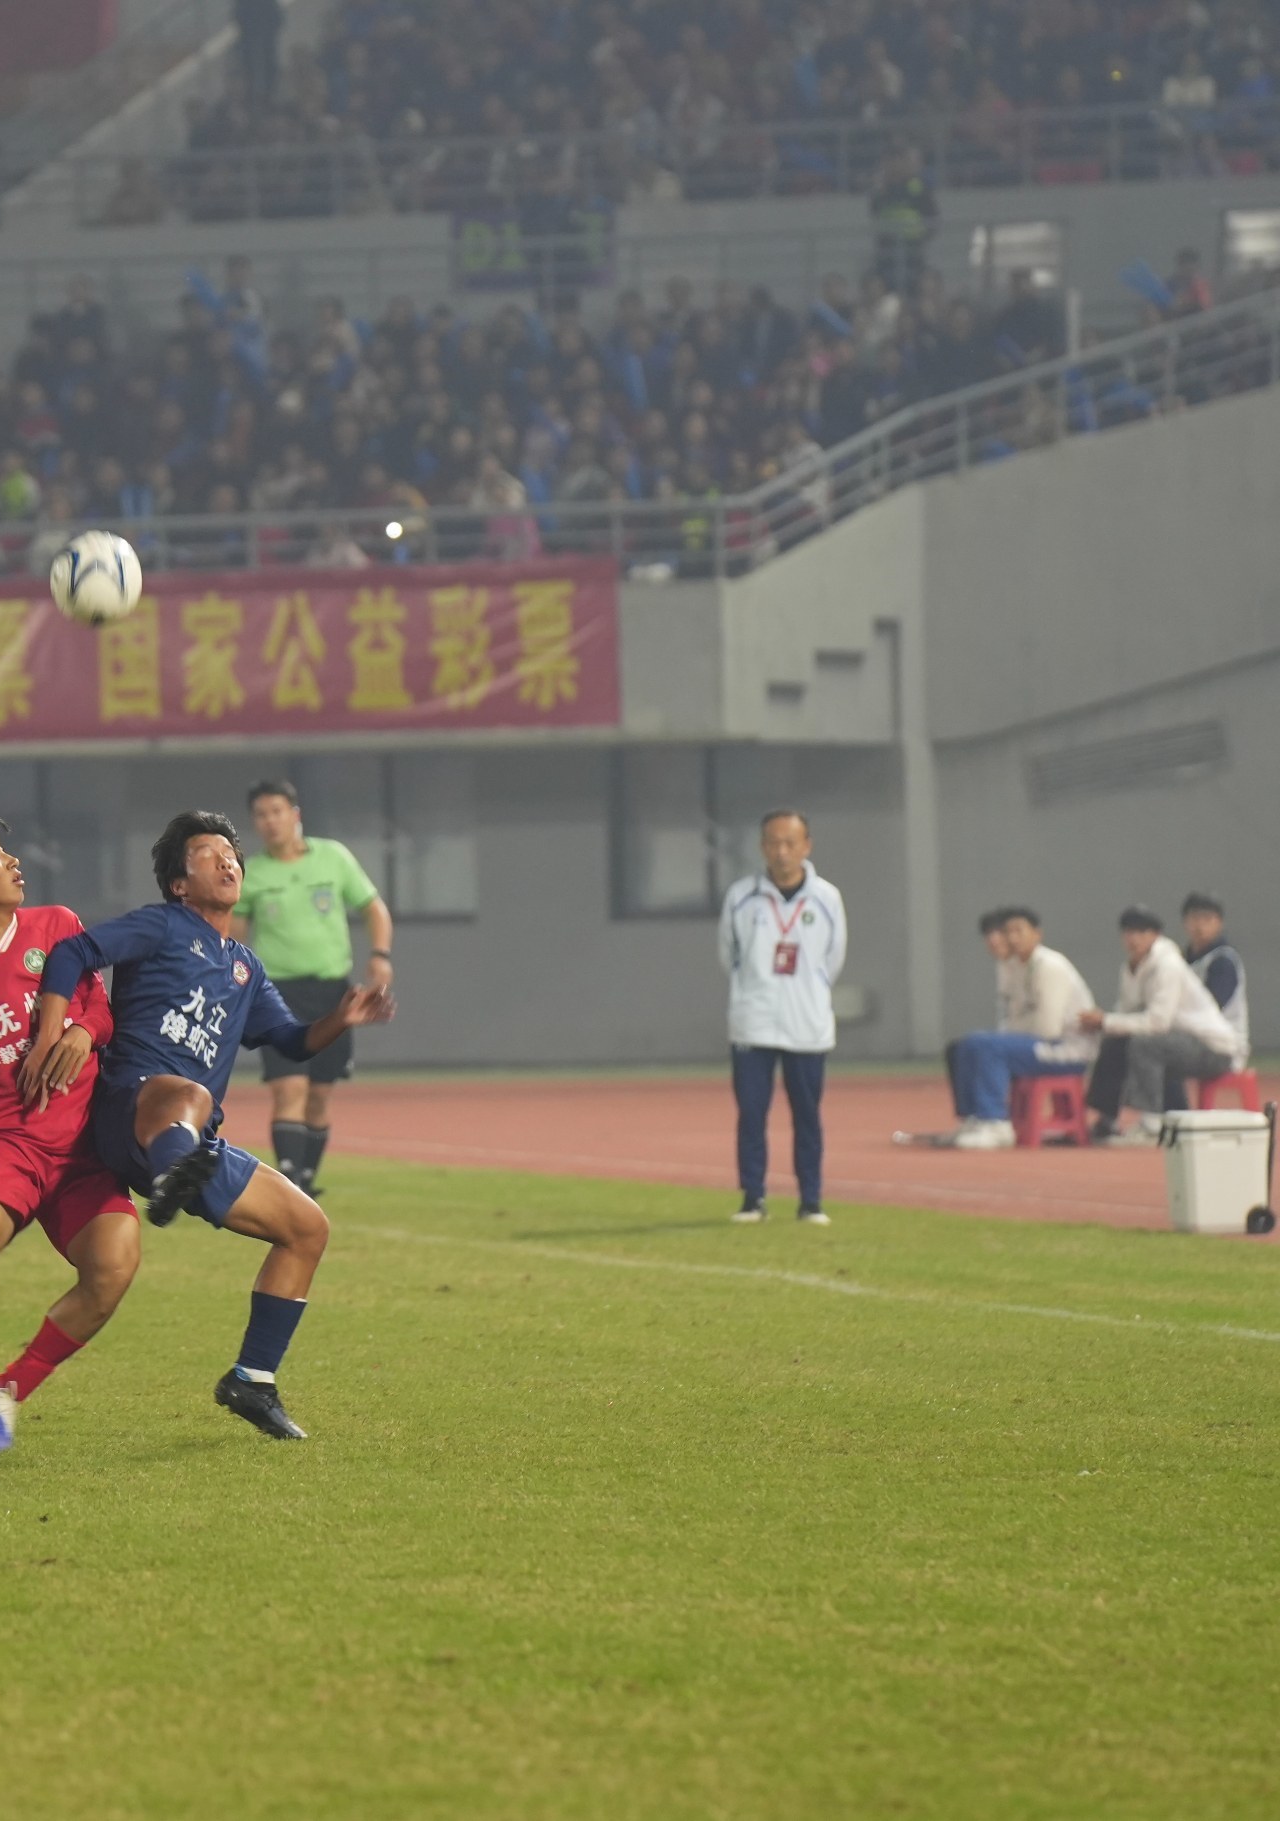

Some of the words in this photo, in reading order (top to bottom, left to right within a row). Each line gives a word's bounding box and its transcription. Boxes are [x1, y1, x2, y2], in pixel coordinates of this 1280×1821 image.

[98, 579, 579, 722] 国家公益彩票
[180, 985, 227, 1036] 九江
